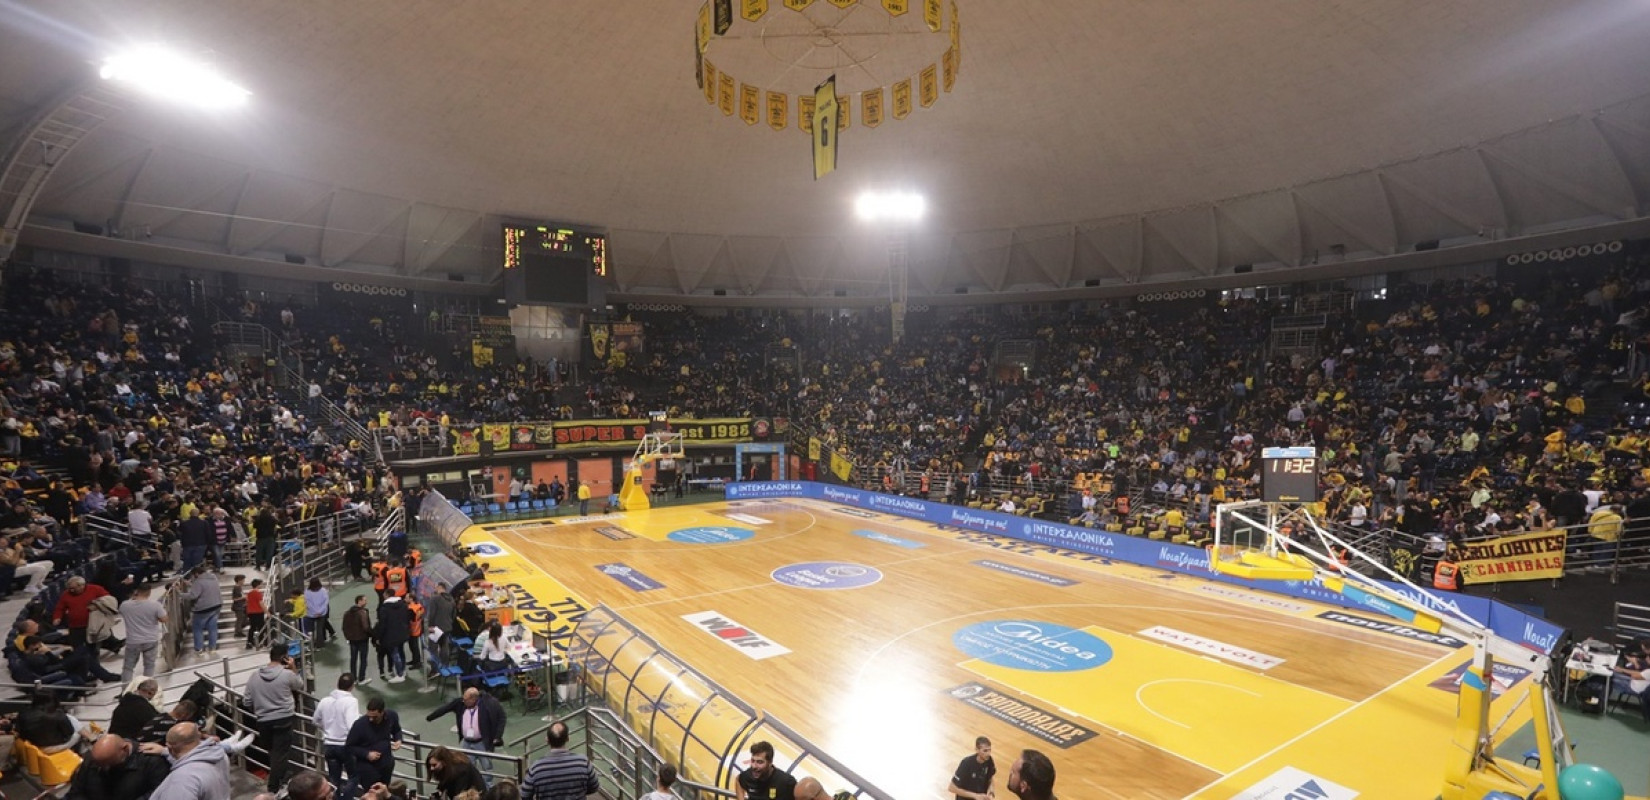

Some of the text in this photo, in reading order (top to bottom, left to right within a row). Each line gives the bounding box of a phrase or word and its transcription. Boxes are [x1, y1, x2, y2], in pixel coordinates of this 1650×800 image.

[821, 116, 828, 147] 6
[555, 427, 625, 443] SUPER
[634, 425, 646, 439] 3
[679, 427, 704, 438] est
[1033, 523, 1115, 547] ΙΝΤΕΡΣΑΛΟΝΙΚΑ
[1477, 557, 1561, 576] CANNIBALS
[994, 622, 1097, 660] Midea
[1326, 613, 1458, 646] novibet
[1153, 628, 1276, 666] WATT+VOLT
